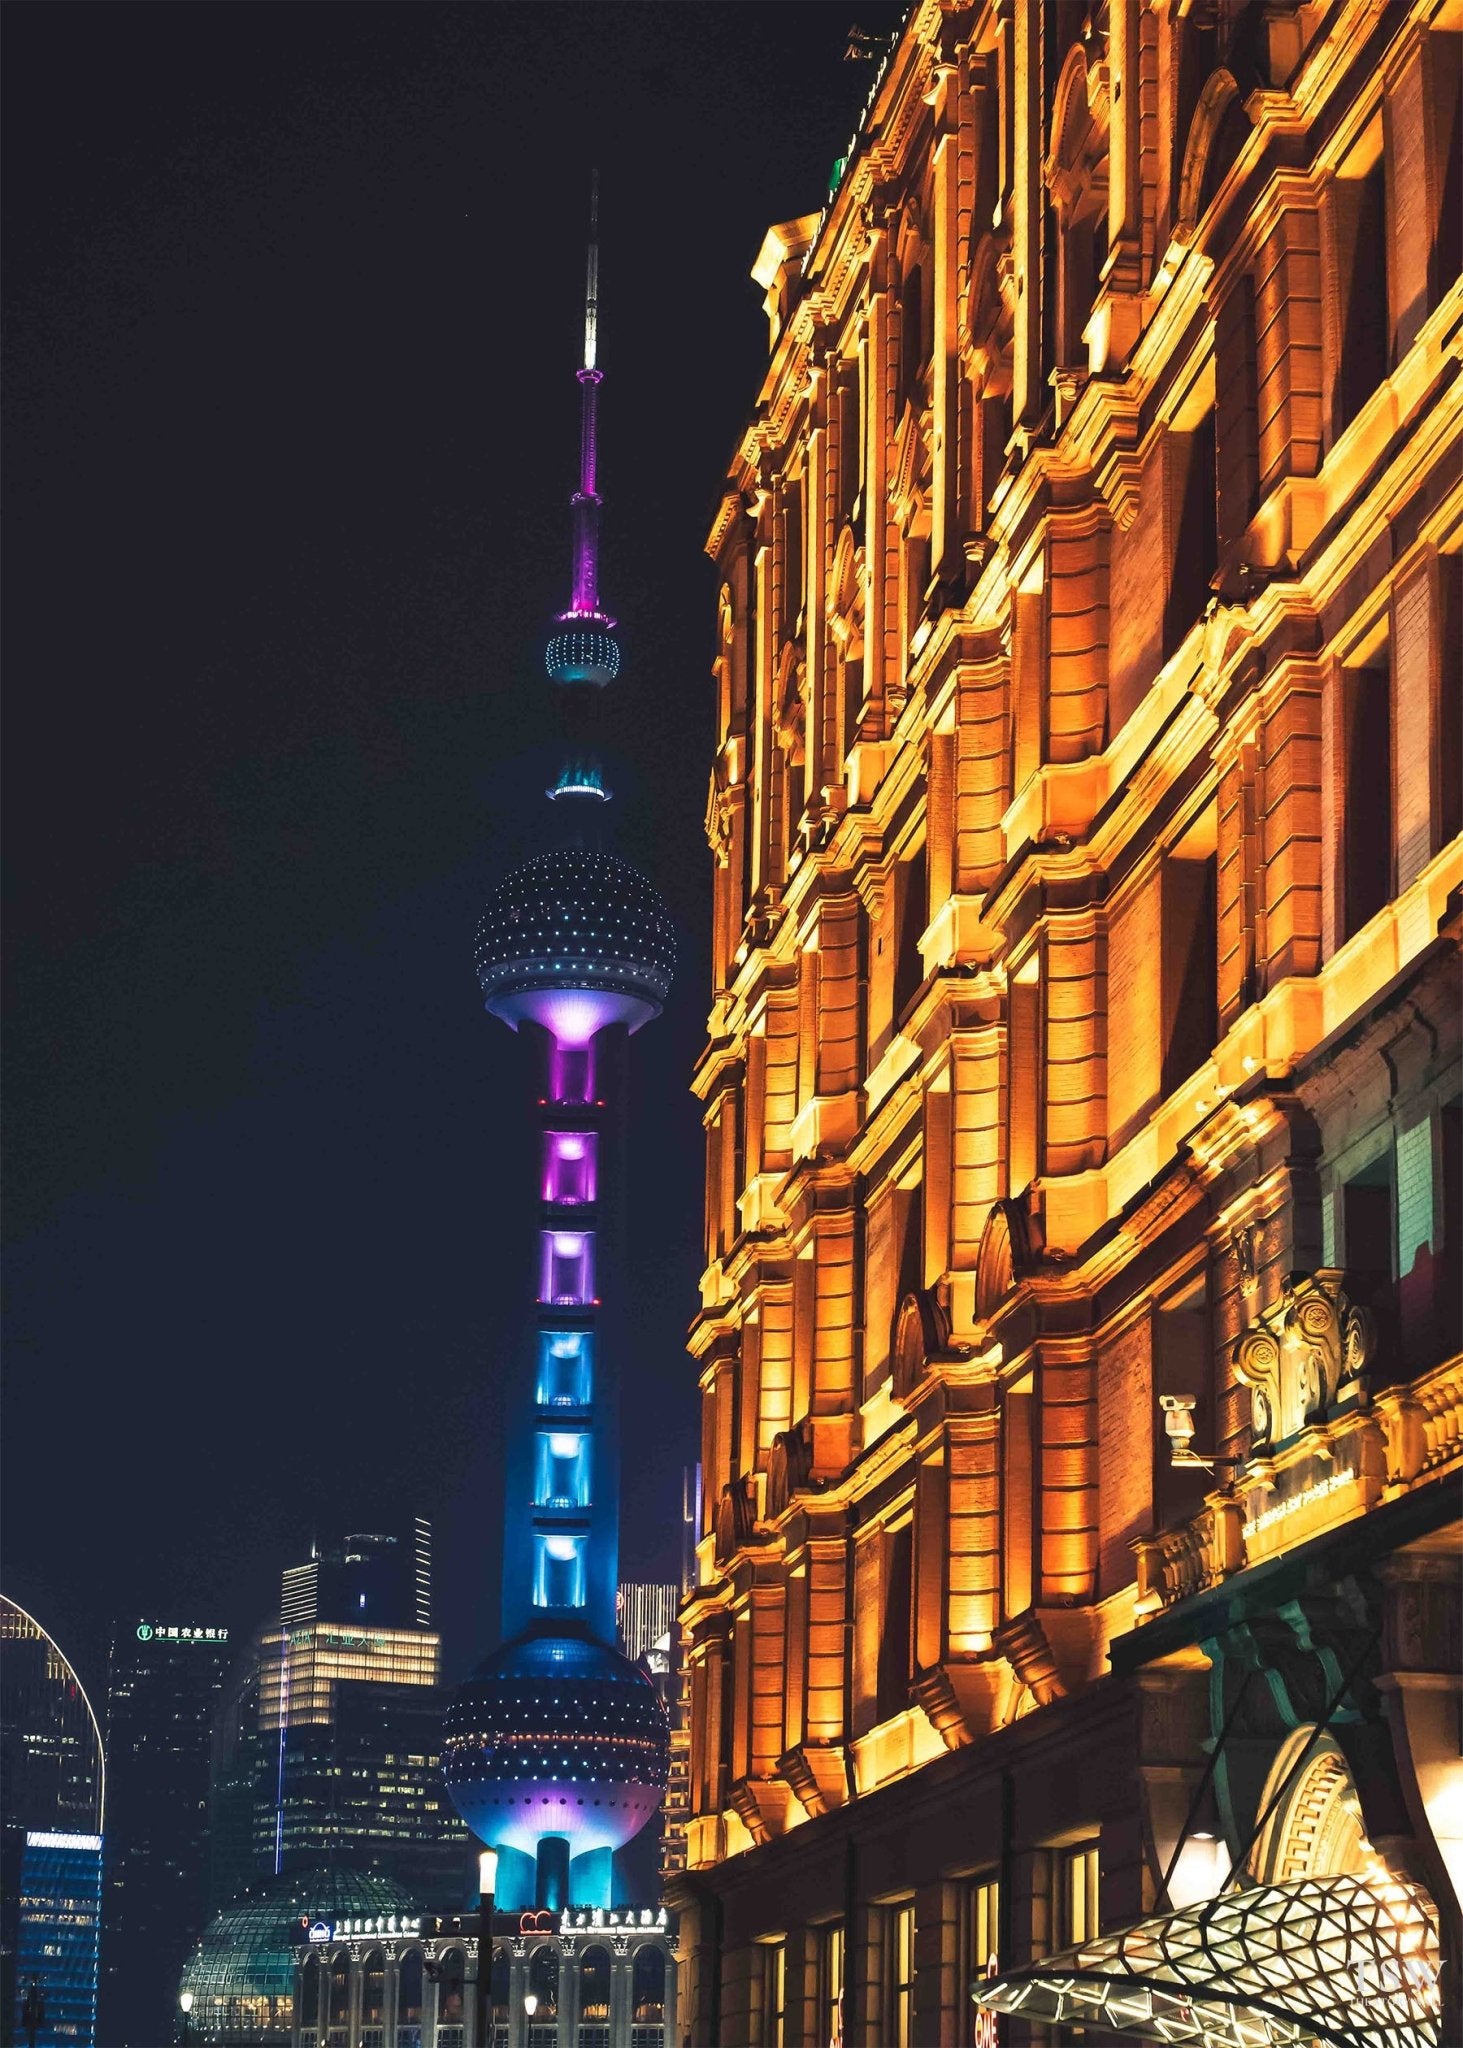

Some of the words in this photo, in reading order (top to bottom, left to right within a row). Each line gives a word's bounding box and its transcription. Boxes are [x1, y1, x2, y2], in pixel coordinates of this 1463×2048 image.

[155, 1626, 229, 1639] 中国农业银行
[974, 2011, 999, 2048] OME
